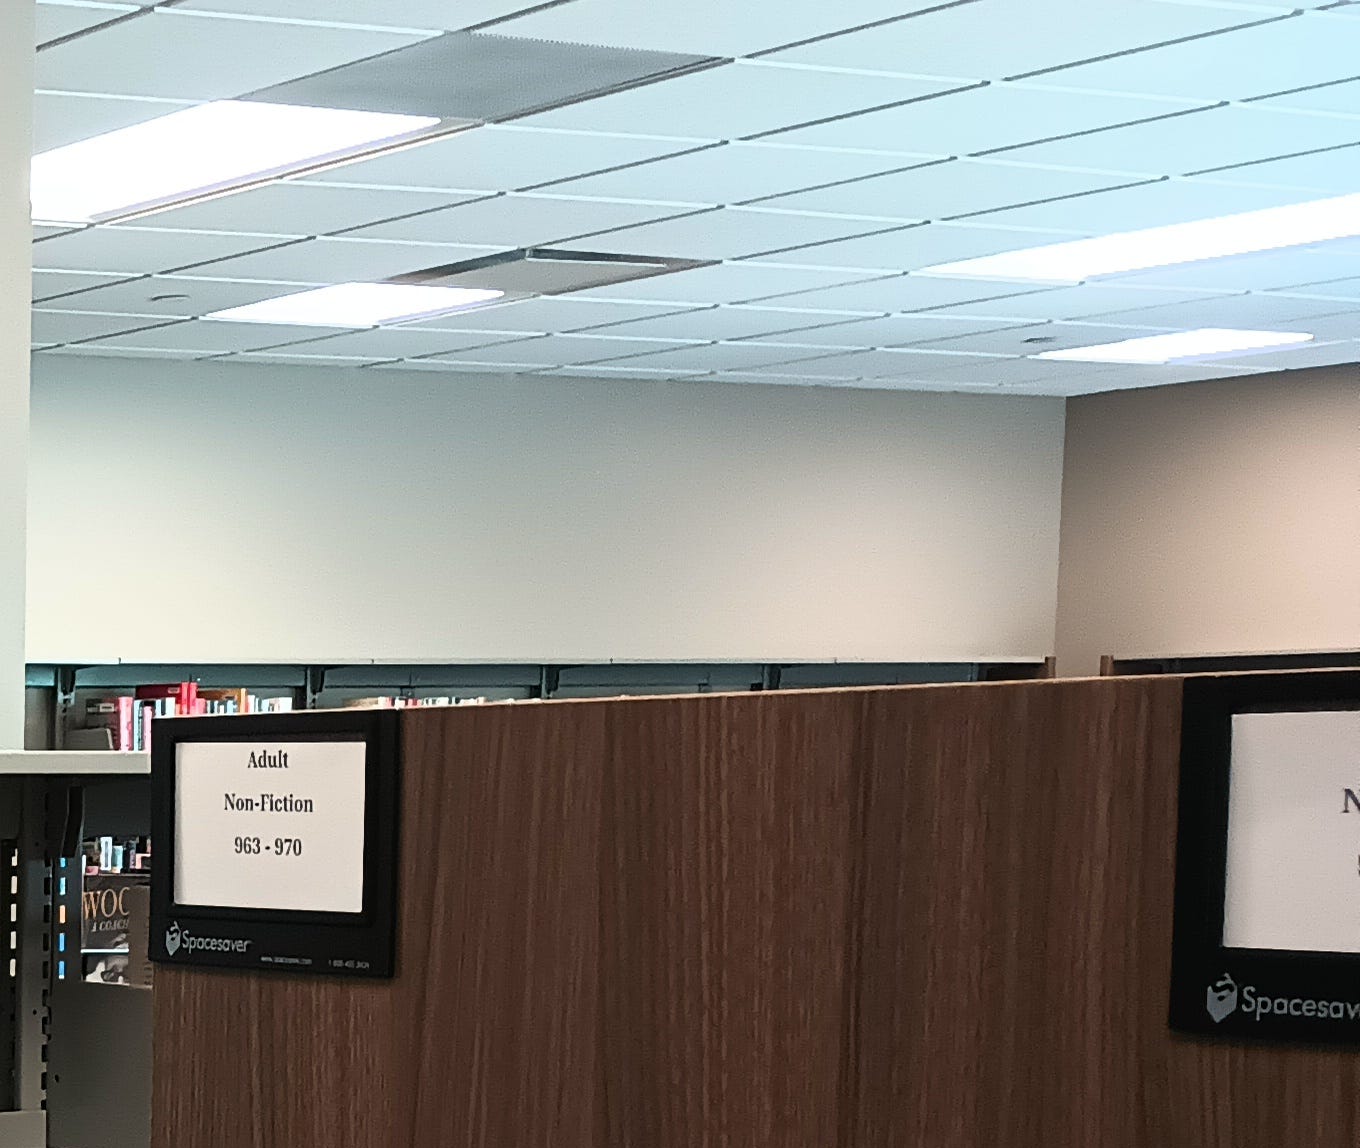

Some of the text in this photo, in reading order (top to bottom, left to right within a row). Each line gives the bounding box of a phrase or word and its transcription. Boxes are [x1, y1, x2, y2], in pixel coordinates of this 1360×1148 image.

[247, 750, 290, 770] Adult
[223, 793, 315, 814] Non-Fiction
[233, 836, 262, 856] 963
[274, 837, 303, 858] 970
[180, 930, 252, 954] Spacesaver
[1241, 985, 1360, 1021] Spacesav
